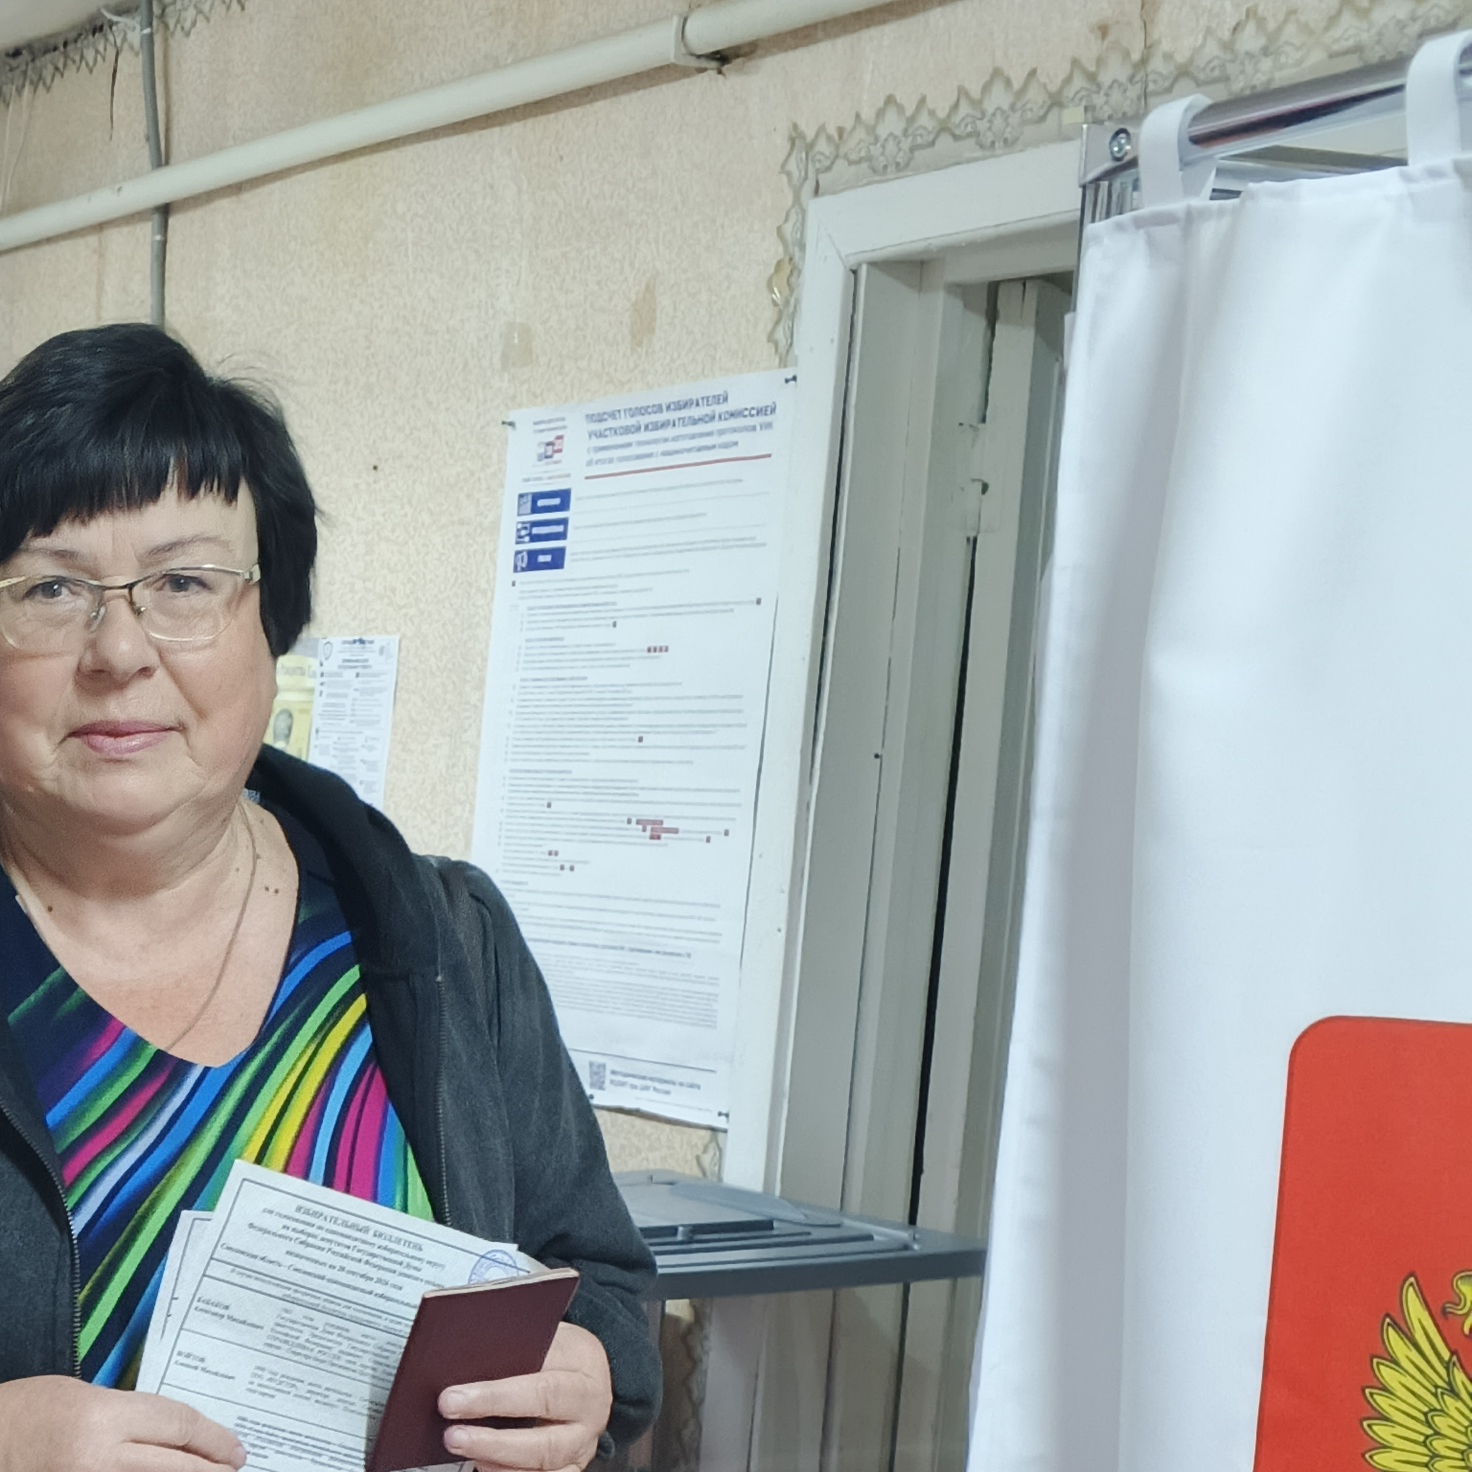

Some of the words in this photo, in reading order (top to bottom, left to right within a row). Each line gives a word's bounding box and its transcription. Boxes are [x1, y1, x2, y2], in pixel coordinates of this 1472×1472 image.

[585, 409, 621, 424] ПОДСЧЕТ
[624, 404, 664, 418] ГОЛОСОВ
[665, 391, 729, 413] ИЗБИРАТЕЛЕЙ
[587, 421, 642, 440] УЧАСТКОВОЙ
[643, 411, 716, 433] ИЗБИРАТЕЛЬНОЙ
[718, 402, 777, 422] КОМИССИЕЙ
